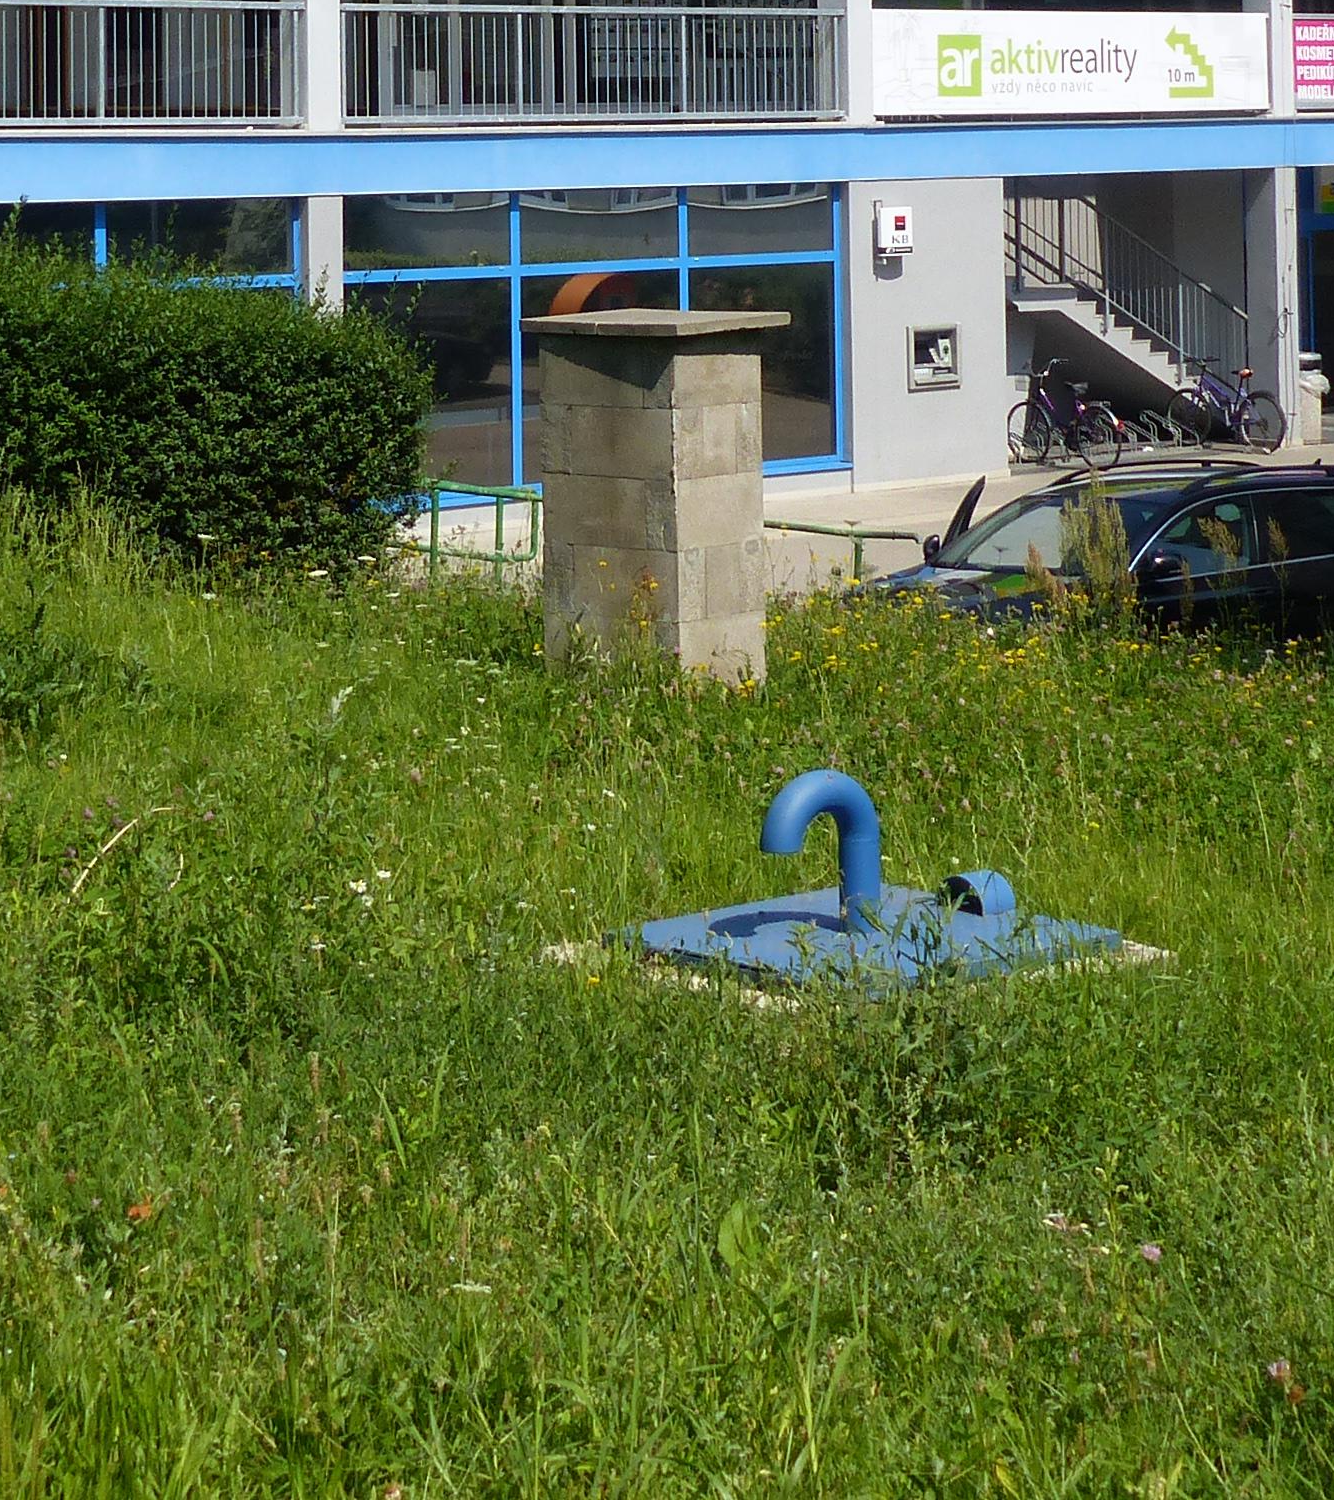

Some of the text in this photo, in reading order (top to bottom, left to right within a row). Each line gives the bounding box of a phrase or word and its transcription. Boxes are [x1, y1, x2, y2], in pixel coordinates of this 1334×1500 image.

[940, 38, 1137, 88] ar aktivreality
[1168, 68, 1196, 83] 10 m
[992, 79, 1021, 95] vždy
[1027, 80, 1057, 93] něco
[892, 234, 909, 244] KB
